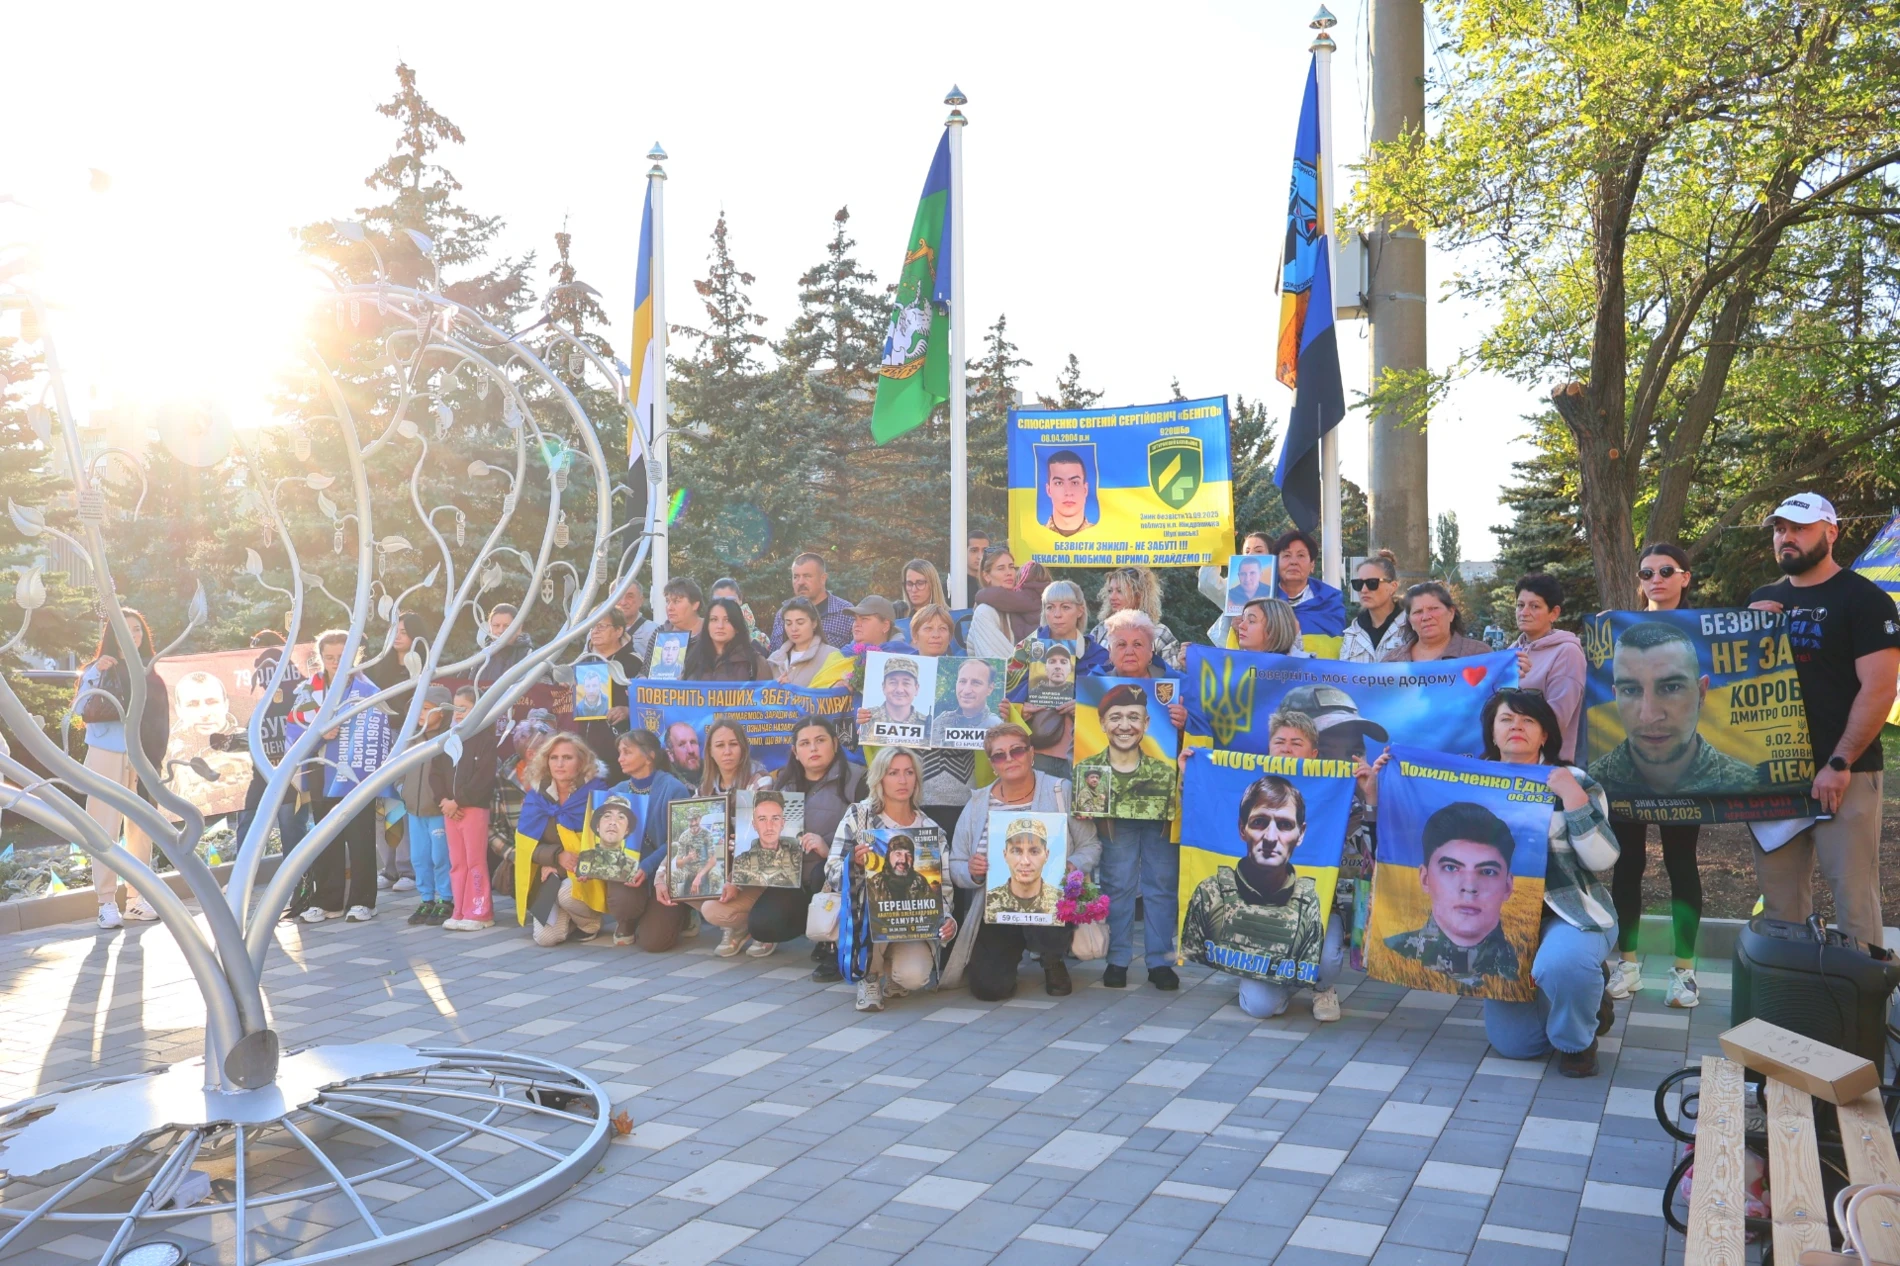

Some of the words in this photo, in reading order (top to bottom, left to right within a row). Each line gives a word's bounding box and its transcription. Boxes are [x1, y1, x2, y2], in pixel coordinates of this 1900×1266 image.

[1018, 417, 1078, 429] СЛЮСАРЕНКО
[1080, 414, 1117, 428] ЄВГЕНІЙ
[1119, 410, 1176, 427] СЕРГІЙОВИЧ
[1054, 541, 1094, 551] БЕЗВІСТИ
[1096, 541, 1128, 551] ЗНИКЛІ
[1135, 540, 1146, 550] НЕ
[1147, 540, 1177, 551] ЗАБУТІ
[1179, 540, 1188, 550] !!!
[1153, 552, 1200, 565] ЗНАЙДЕМО
[1711, 640, 1749, 675] НЕ
[1758, 633, 1794, 670] ЗА
[233, 669, 251, 687] 79
[1249, 666, 1317, 684] Поверніть
[1322, 672, 1348, 684] моє
[1352, 675, 1395, 687] серце
[1398, 673, 1456, 688] додому
[637, 686, 704, 706] ПОВЕРНІТЬ
[708, 688, 757, 707] НАШИХ.
[1730, 678, 1804, 708] КОРОБ
[1730, 707, 1778, 725] ДМИТРО
[1781, 704, 1805, 718] ОЛЕ
[875, 724, 921, 738] БАТЯ
[364, 715, 381, 772] 09.01.1986
[1212, 750, 1298, 775] МОВЧАН
[1769, 760, 1815, 783] НЕМ
[1400, 761, 1511, 790] Похильченко
[1635, 799, 1657, 807] ЗНИК
[1636, 807, 1702, 821] 20.10.2025
[878, 899, 936, 912] ТЕРЕЩЕНКО
[1204, 939, 1272, 975] Зниклі
